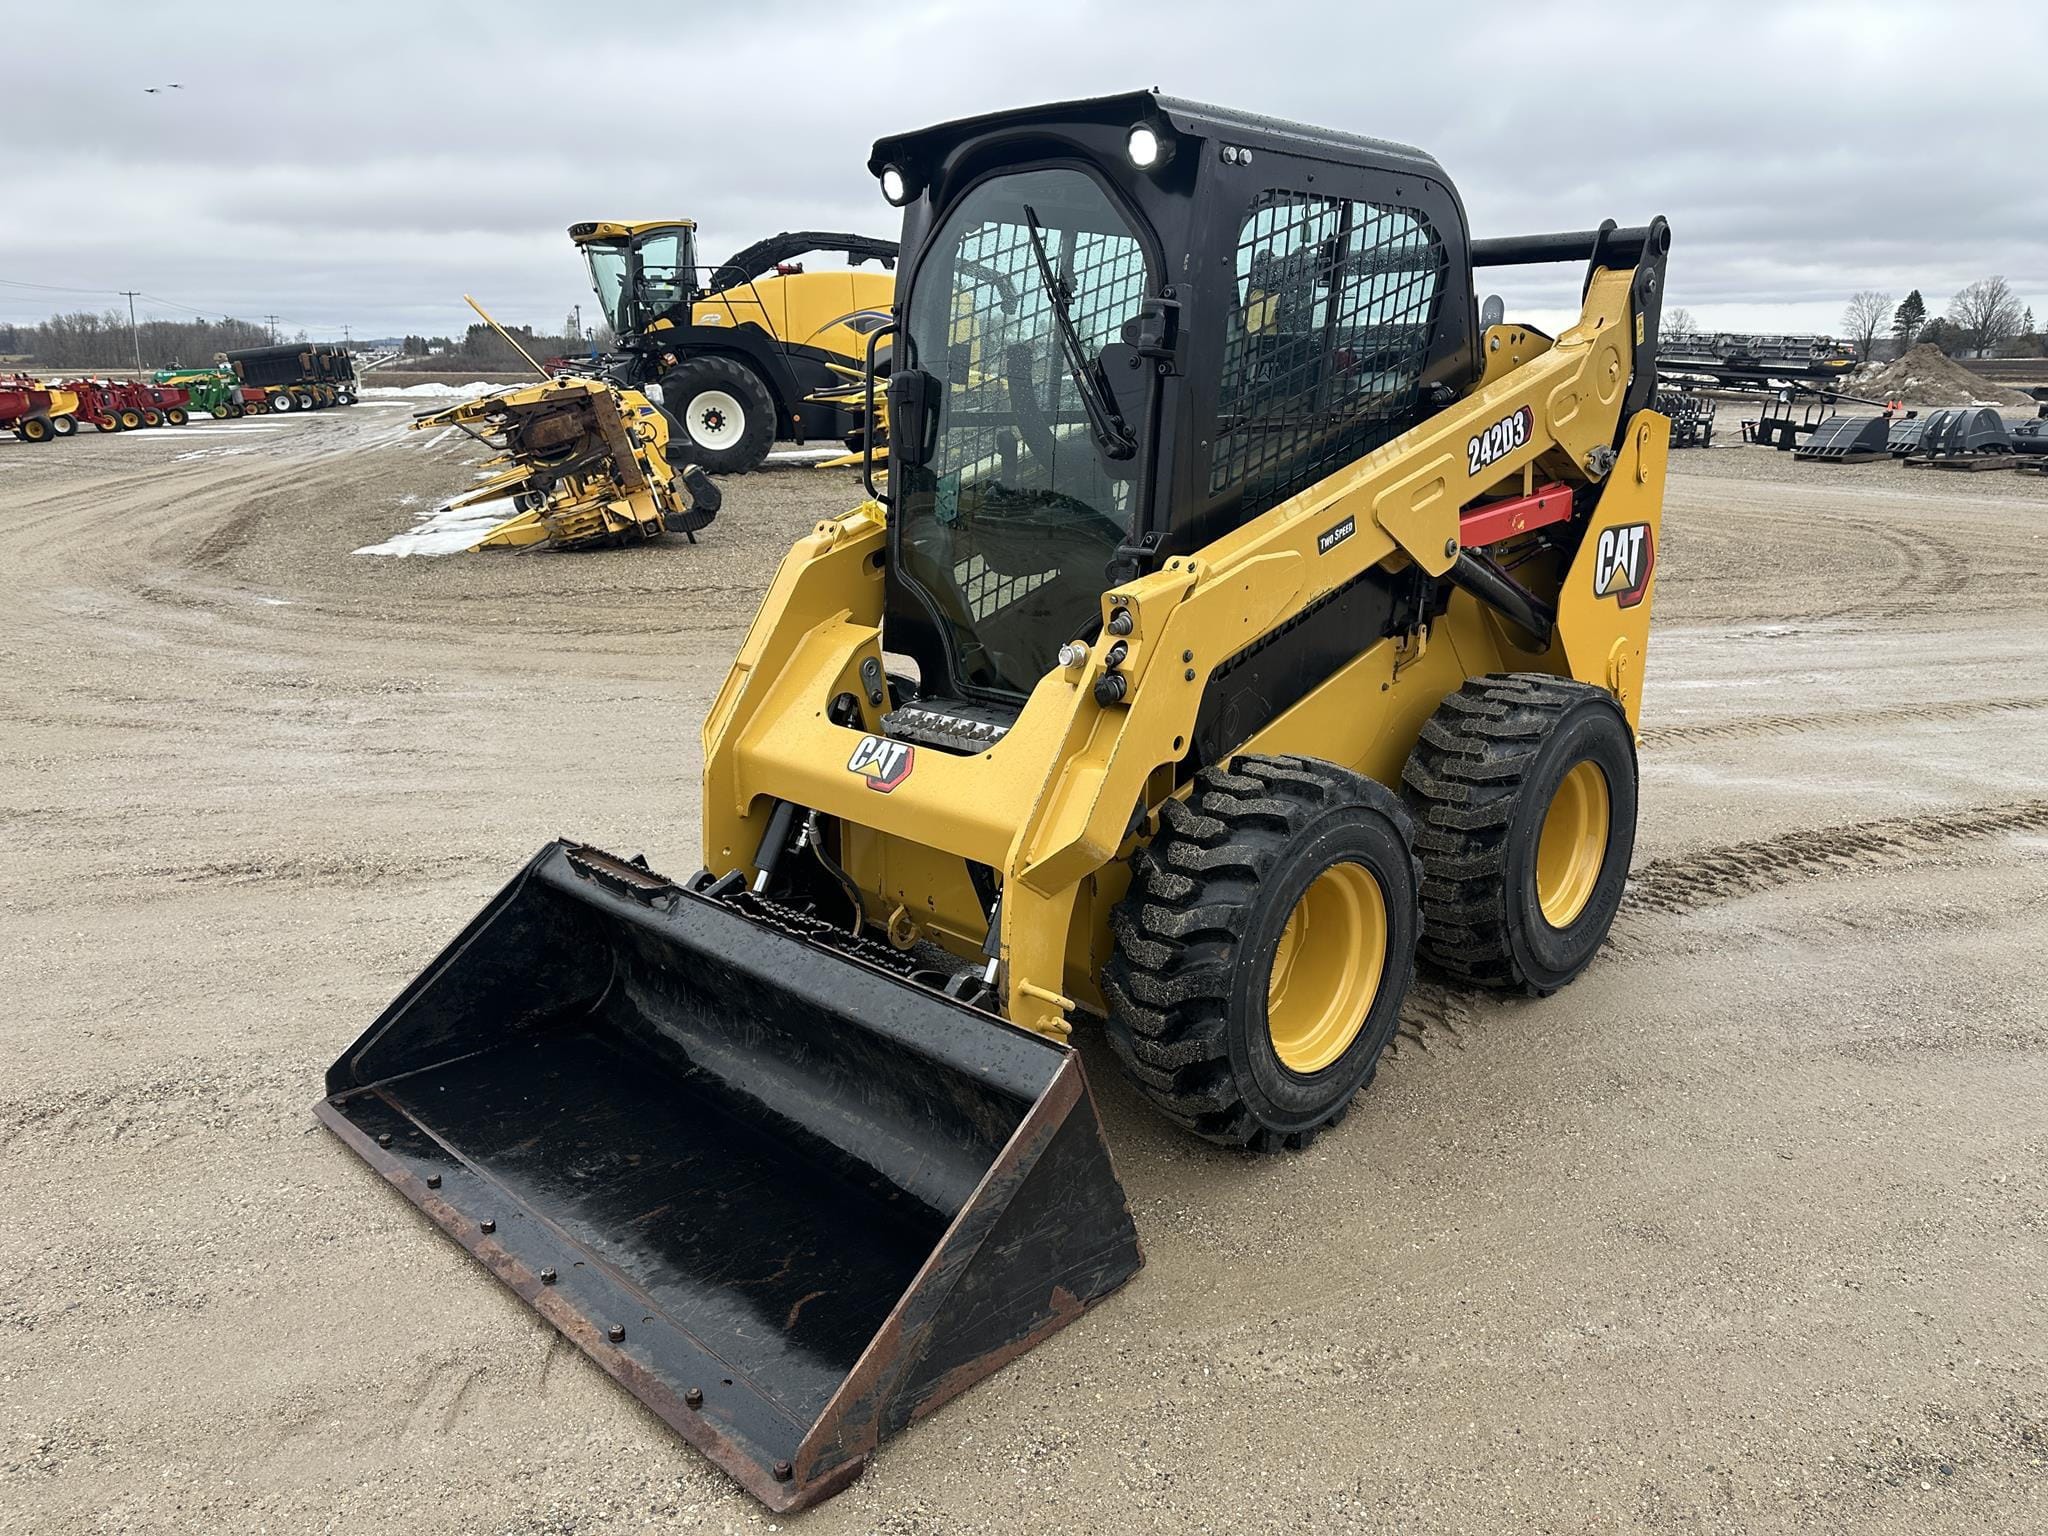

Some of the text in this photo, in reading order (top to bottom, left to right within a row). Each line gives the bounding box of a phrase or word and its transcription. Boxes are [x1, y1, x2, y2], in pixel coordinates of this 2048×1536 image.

[1468, 410, 1525, 475] 242D3
[1595, 525, 1645, 595] CAT
[849, 735, 909, 780] CAT
